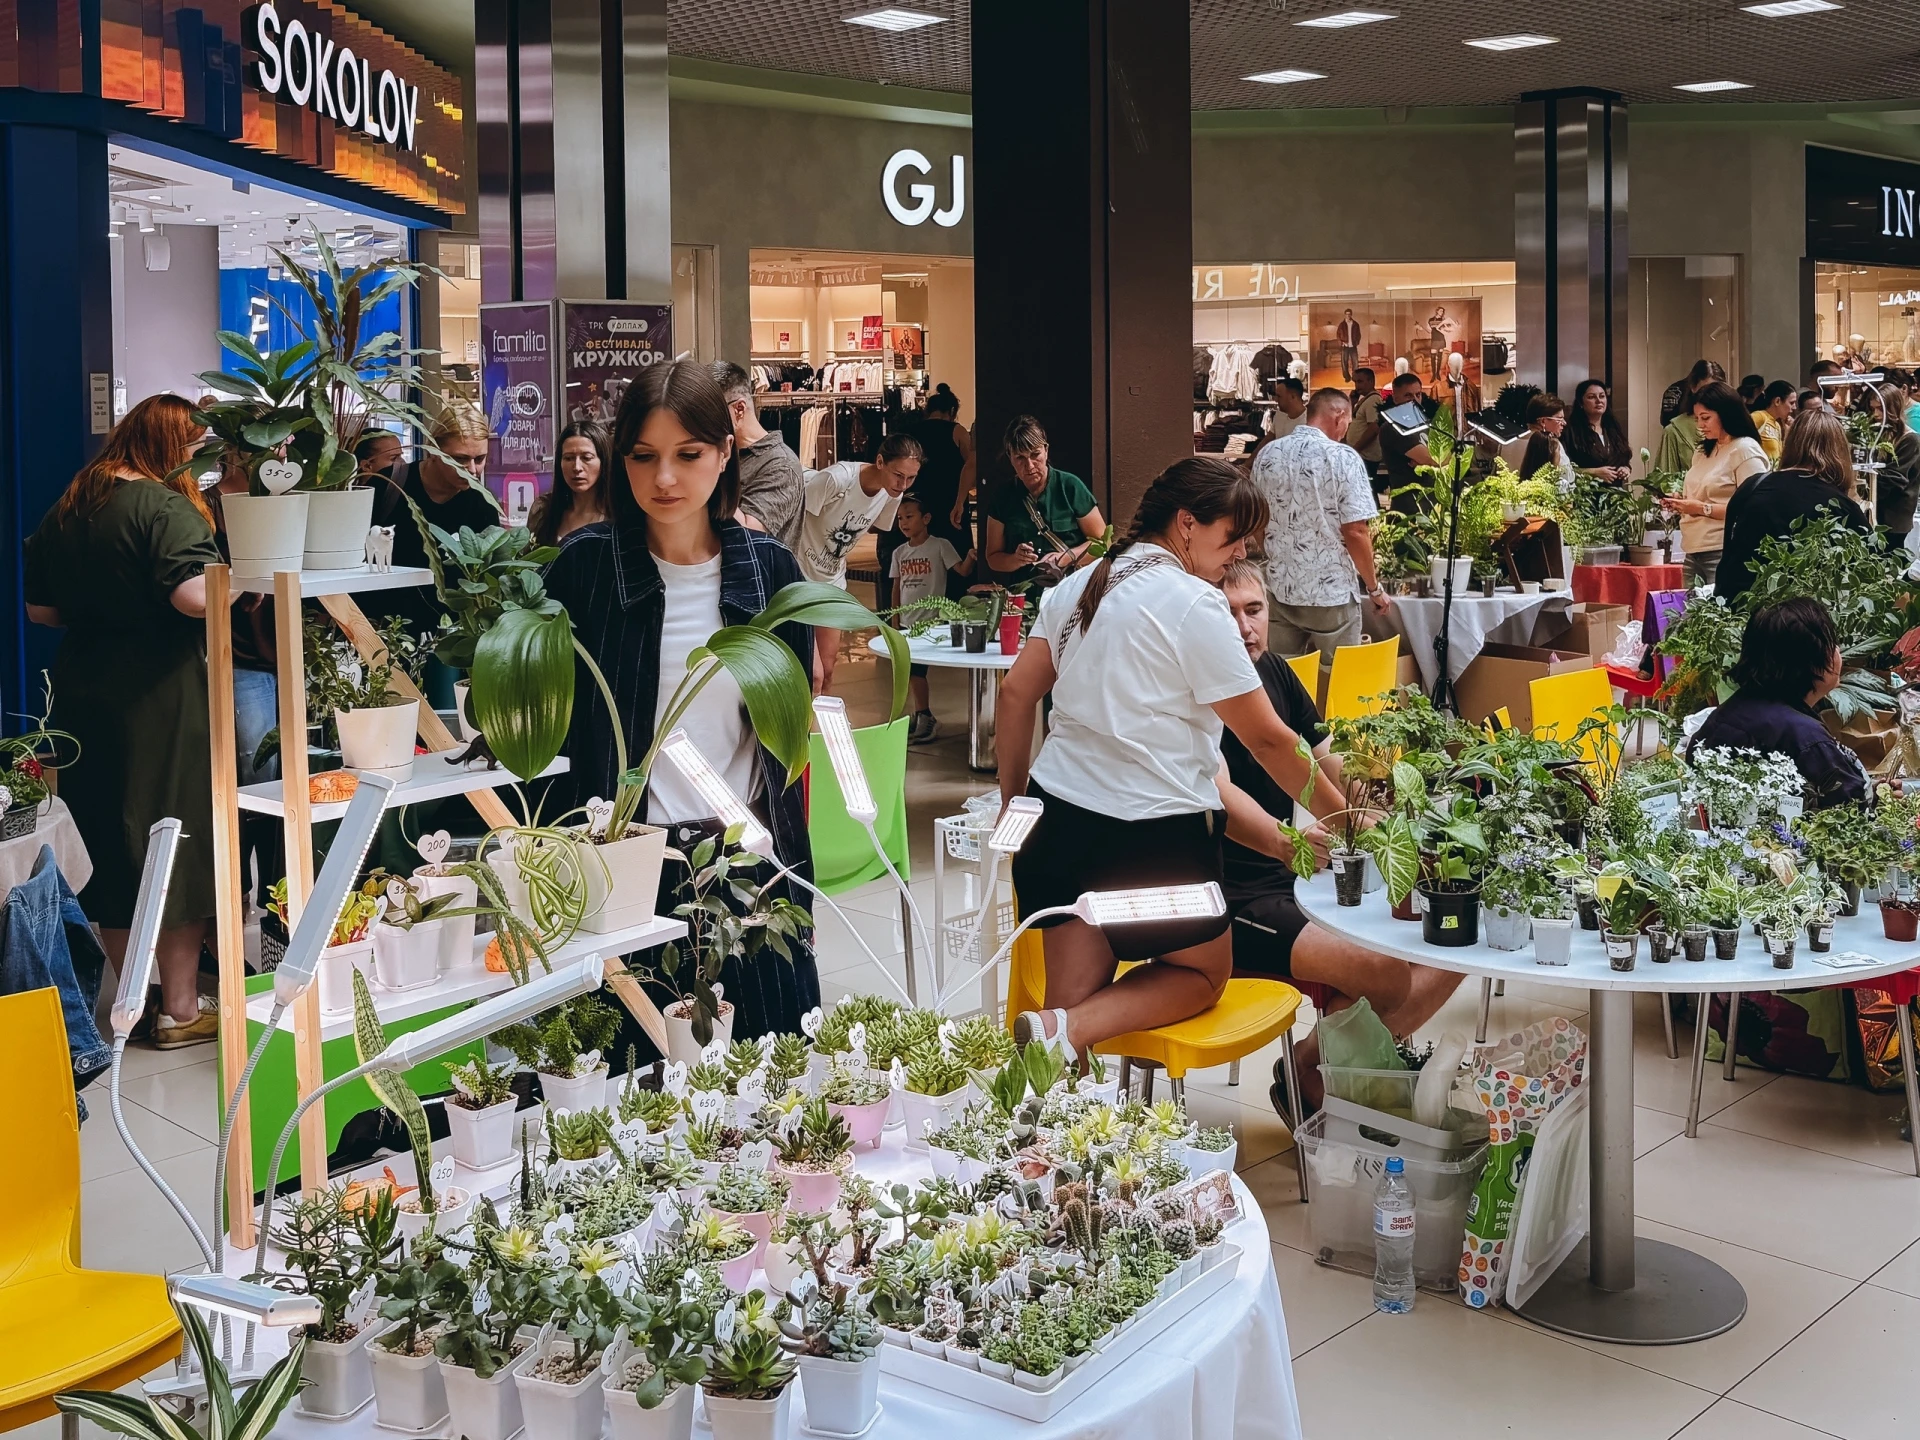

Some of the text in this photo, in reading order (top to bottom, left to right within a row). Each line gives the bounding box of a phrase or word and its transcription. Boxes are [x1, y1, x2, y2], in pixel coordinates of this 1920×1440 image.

[257, 2, 418, 151] SOKOLOV
[882, 148, 965, 227] GJ
[1881, 186, 1920, 238] IN
[588, 321, 604, 330] ТРК
[493, 328, 547, 353] familia
[585, 339, 652, 350] ФЕСТИВАЛЬ
[508, 419, 536, 432] ТОВАРЫ
[503, 436, 541, 449] ДЛЯ ДОМА
[265, 468, 293, 479] 350
[517, 485, 528, 512] 1
[426, 839, 446, 853] 200
[842, 1058, 861, 1067] 650
[746, 1079, 761, 1092] 650
[699, 1098, 717, 1108] 650
[618, 1128, 639, 1141] 650
[747, 1150, 763, 1159] 650
[435, 1167, 453, 1180] 250
